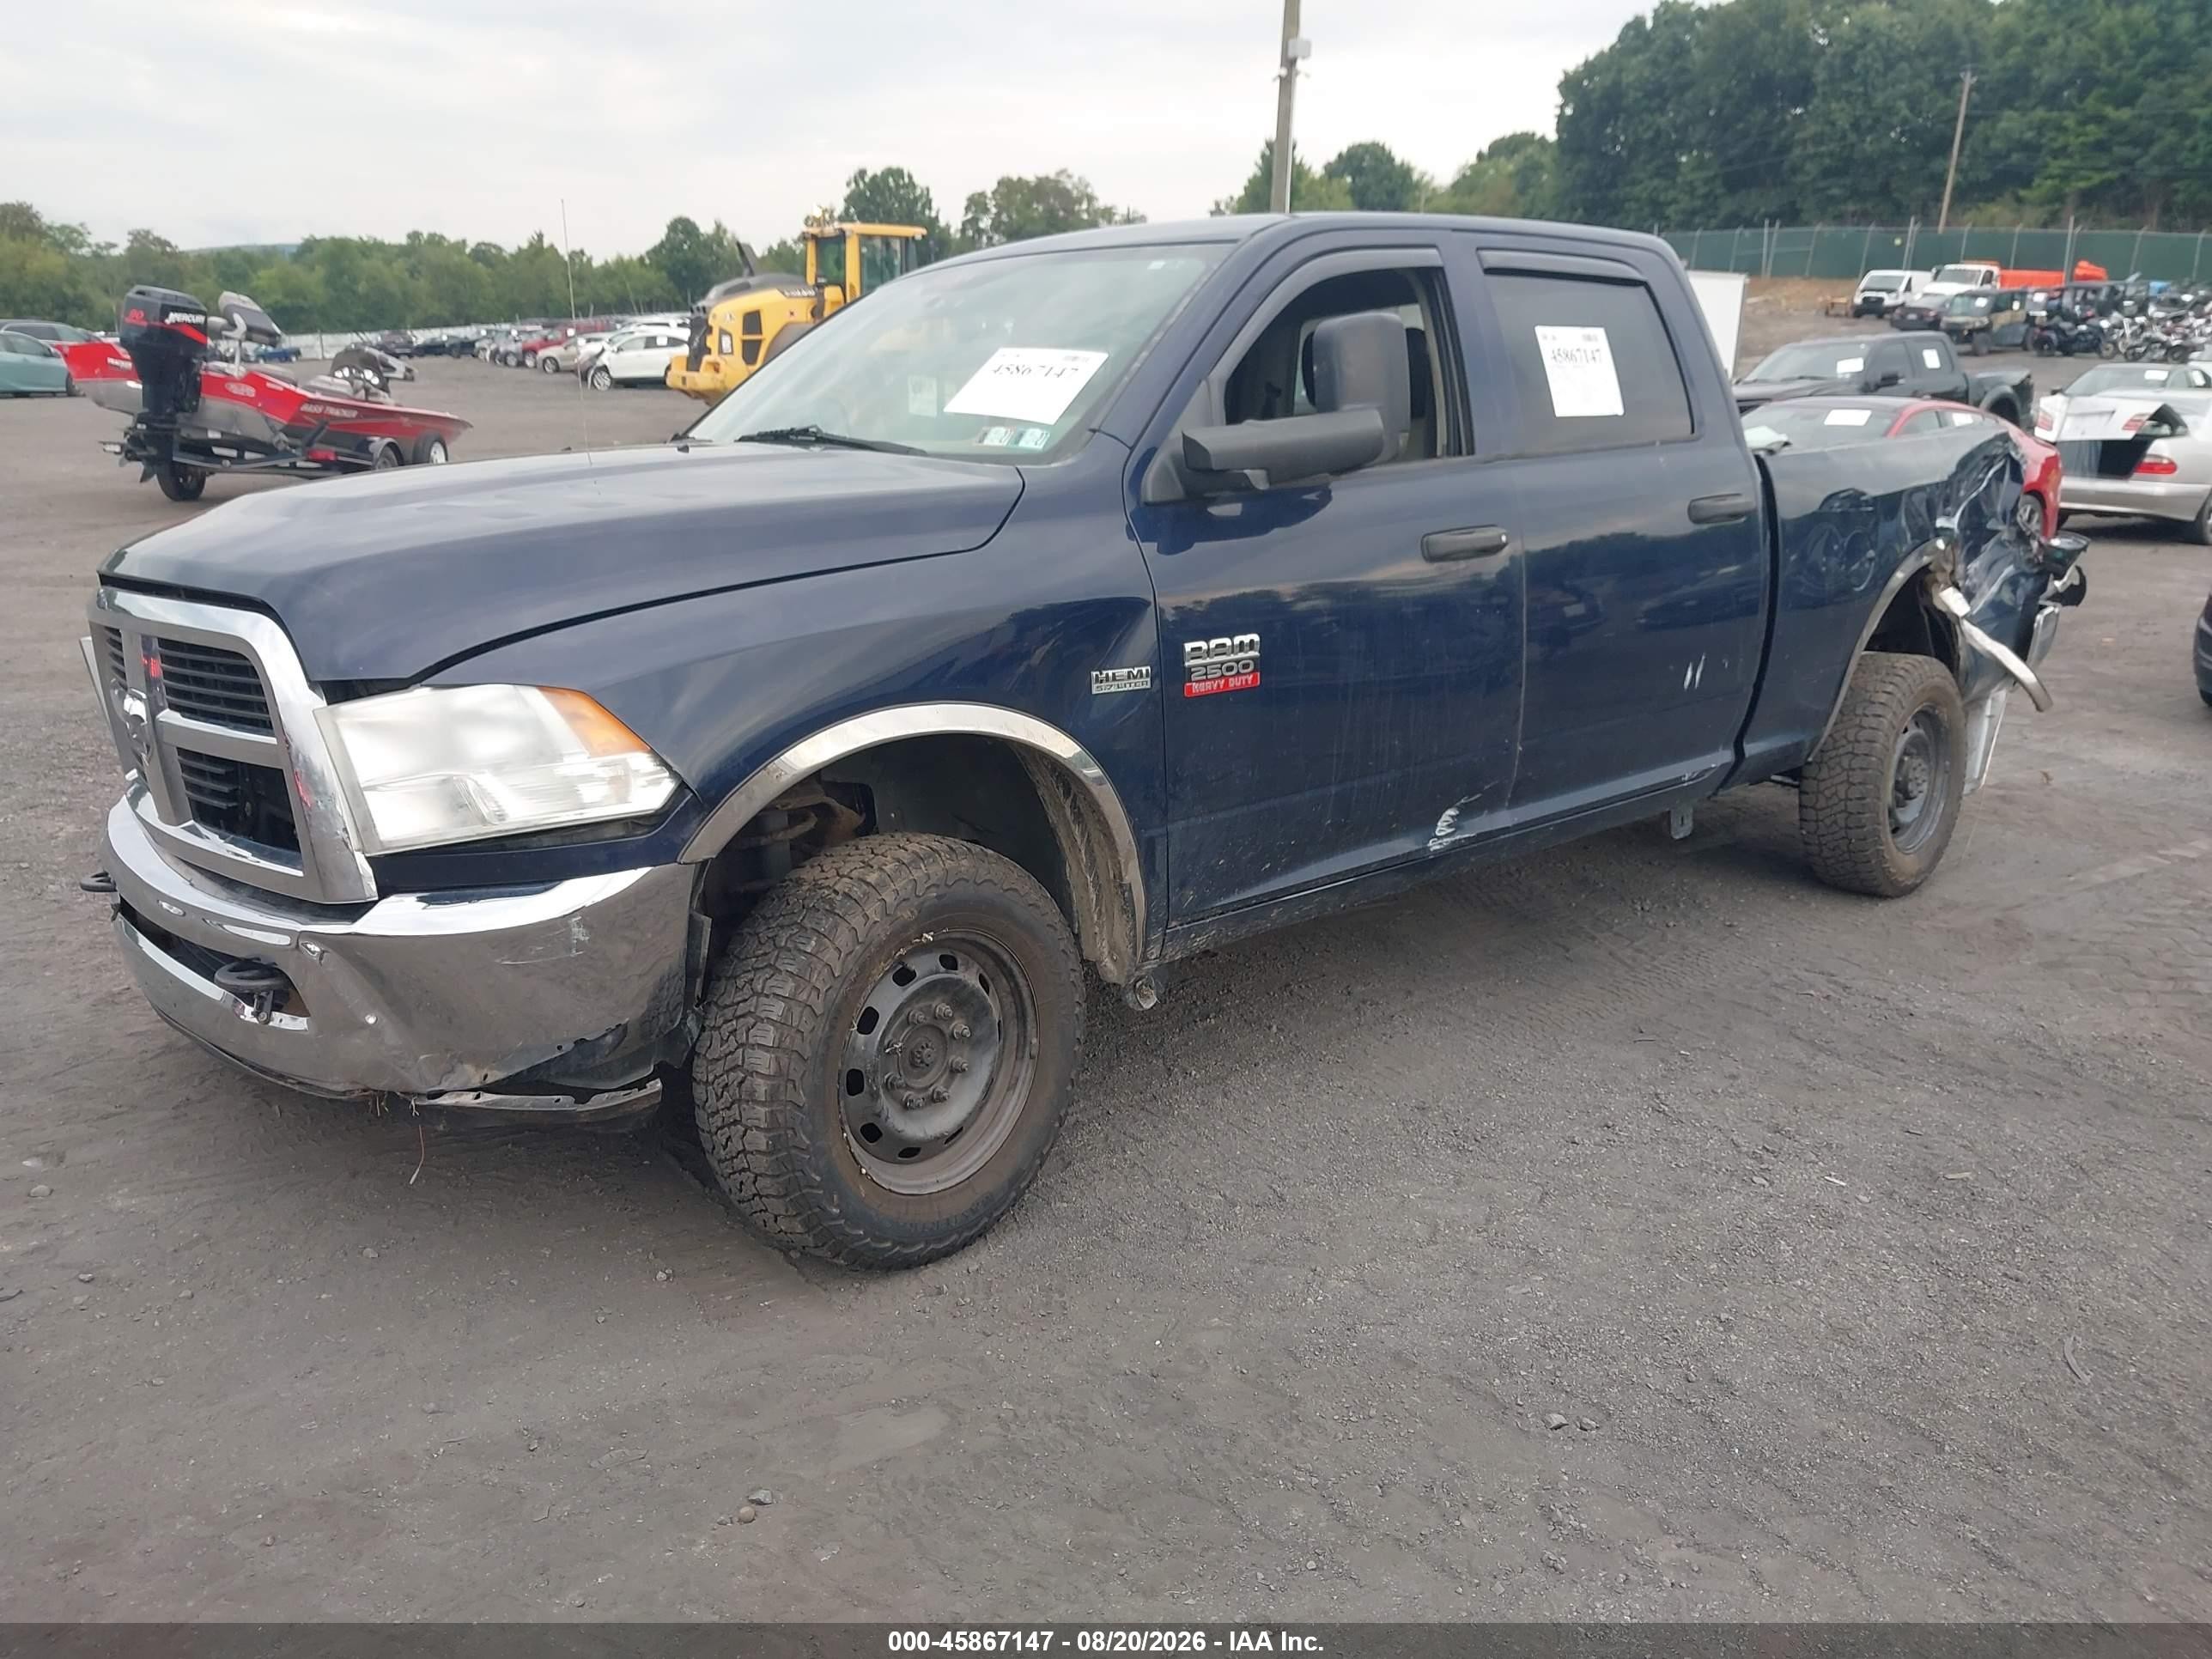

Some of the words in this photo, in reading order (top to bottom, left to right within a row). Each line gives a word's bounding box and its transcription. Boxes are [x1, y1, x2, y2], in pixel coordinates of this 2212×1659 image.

[164, 312, 206, 325] MERCURY
[1551, 347, 1602, 365] 45867147
[1183, 634, 1261, 665] RAM
[1094, 668, 1150, 684] HEMI
[1190, 659, 1255, 681] 2500
[1116, 680, 1149, 690] LITER
[1192, 678, 1225, 694] HEAVY
[1228, 674, 1255, 687] DUTY
